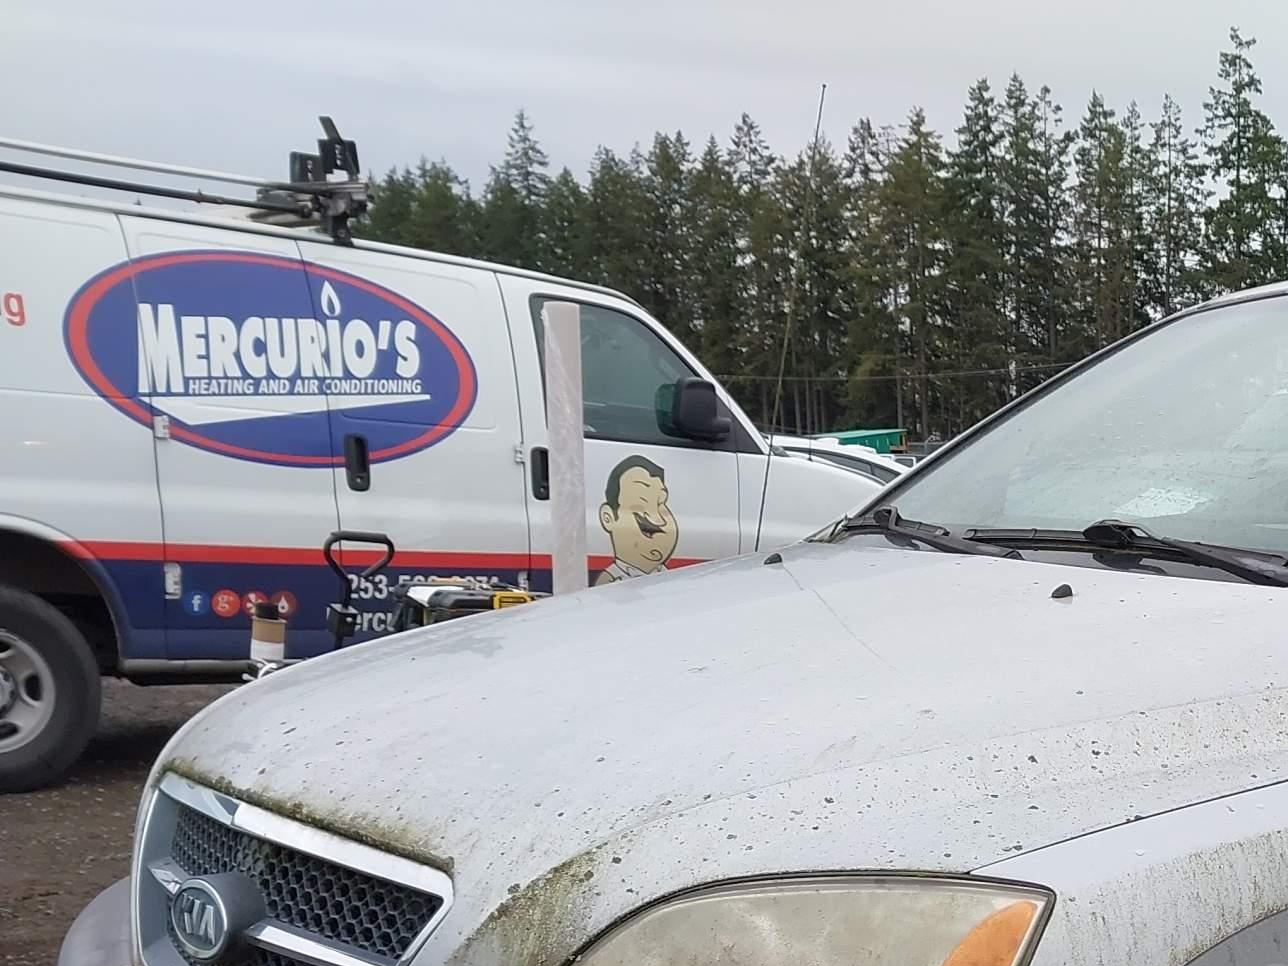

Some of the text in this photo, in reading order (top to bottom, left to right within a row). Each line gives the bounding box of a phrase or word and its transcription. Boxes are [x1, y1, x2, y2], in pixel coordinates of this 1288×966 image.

[138, 303, 421, 393] MERCURIO'S
[189, 379, 422, 395] HEATING AND AIR CONDITIONING
